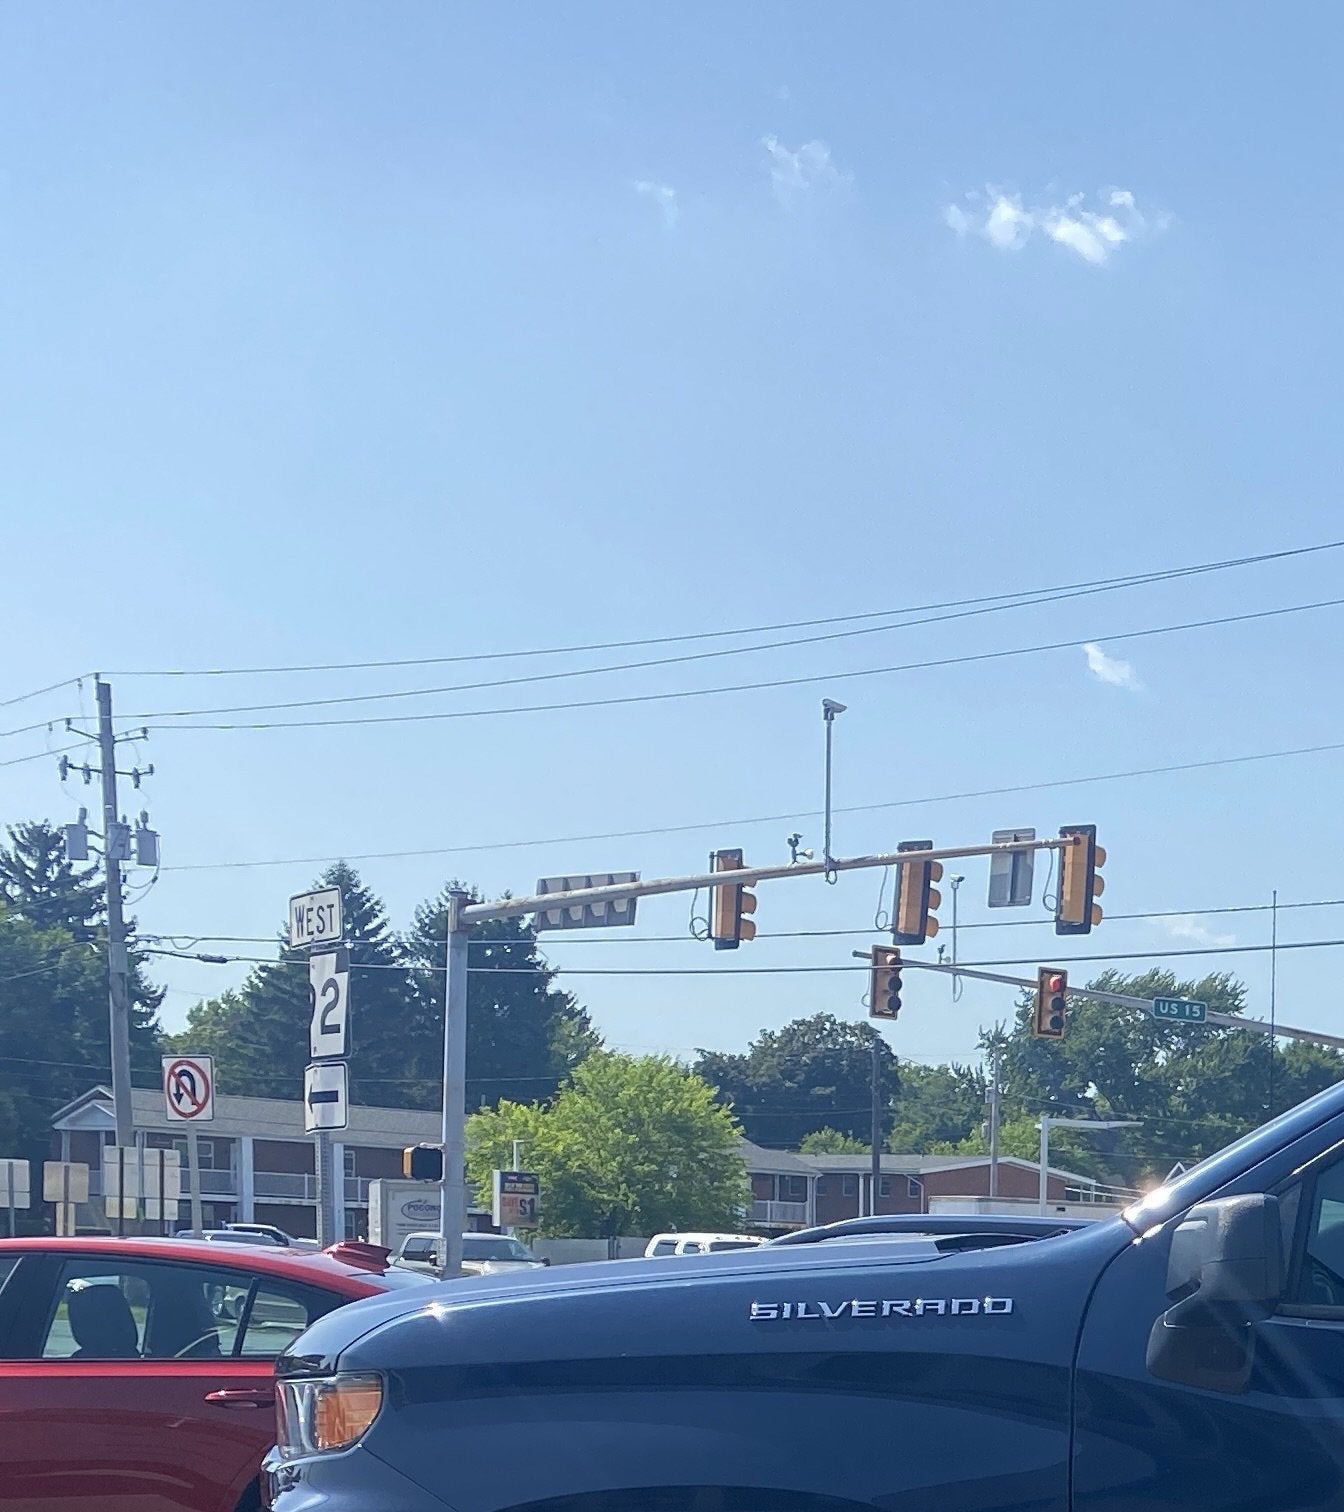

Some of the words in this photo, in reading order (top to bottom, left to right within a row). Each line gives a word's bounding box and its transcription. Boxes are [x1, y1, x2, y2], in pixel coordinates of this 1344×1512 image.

[294, 903, 335, 939] WEST
[310, 977, 342, 1036] 2
[1159, 1001, 1179, 1015] US
[1184, 1004, 1202, 1018] 15
[749, 1296, 1013, 1320] SILVERADO
